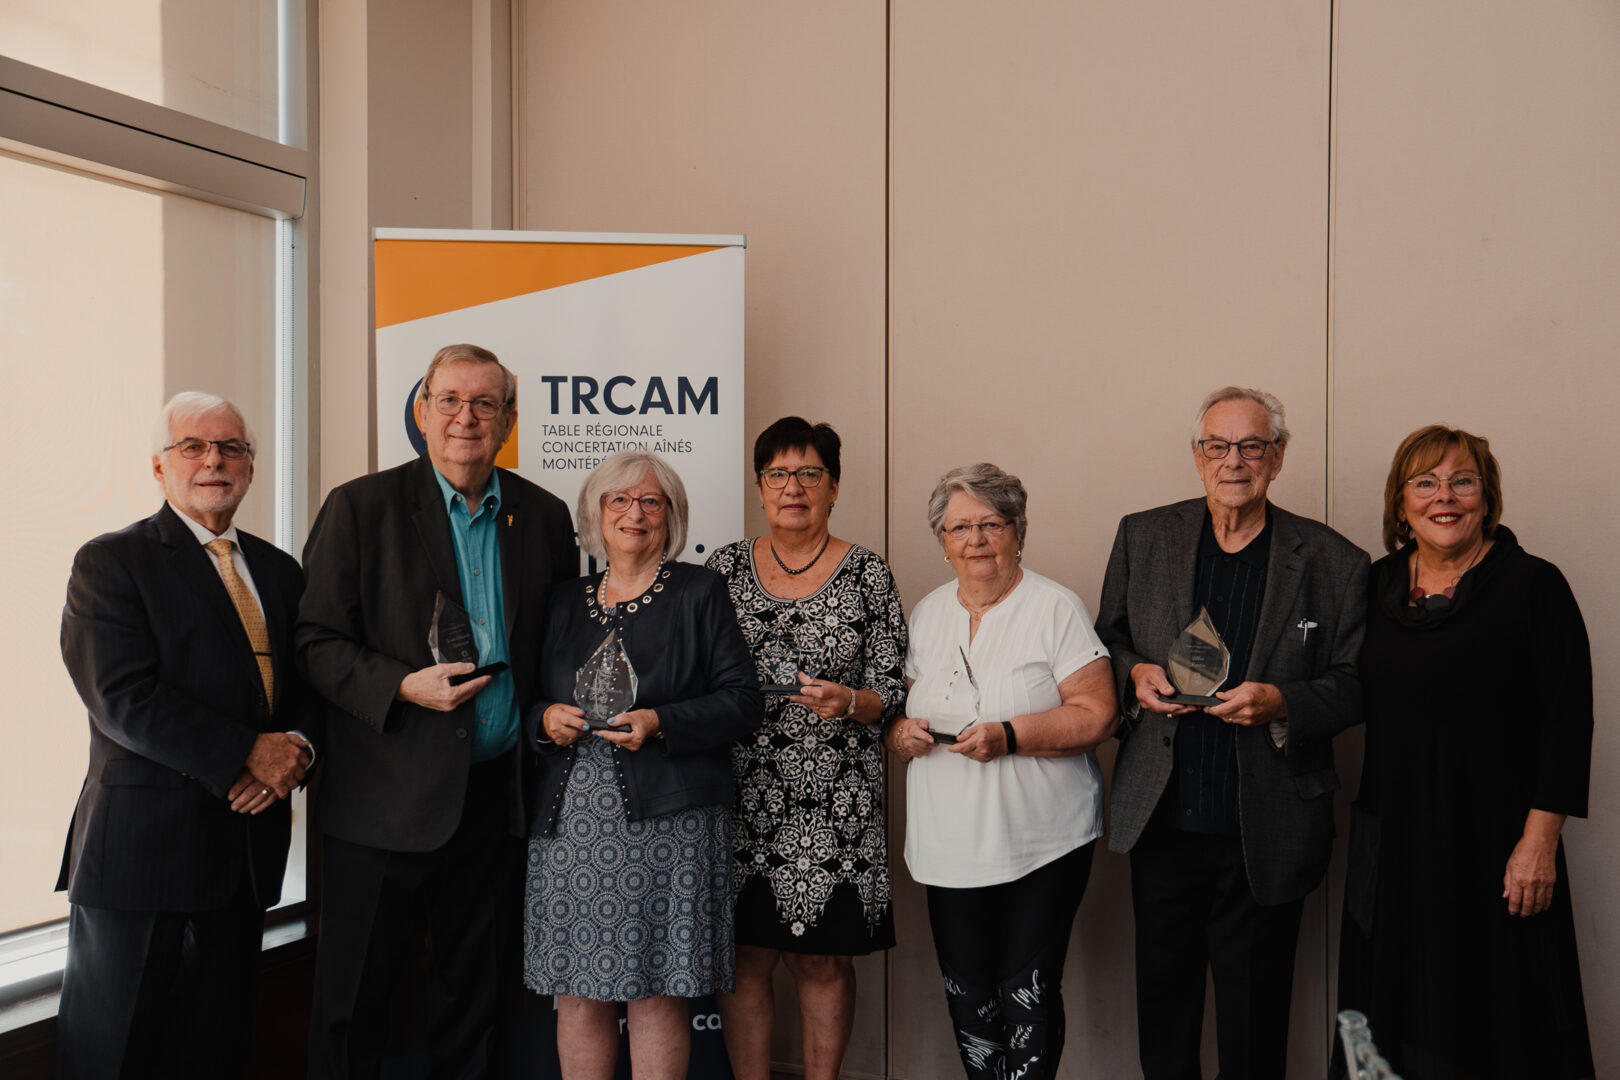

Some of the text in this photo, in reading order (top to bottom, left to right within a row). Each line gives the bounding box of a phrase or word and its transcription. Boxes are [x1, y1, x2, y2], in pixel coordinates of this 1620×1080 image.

[541, 375, 719, 415] TRCAM
[541, 422, 664, 437] TABLE RÉGIONALE
[653, 438, 693, 453] AÎNÉS
